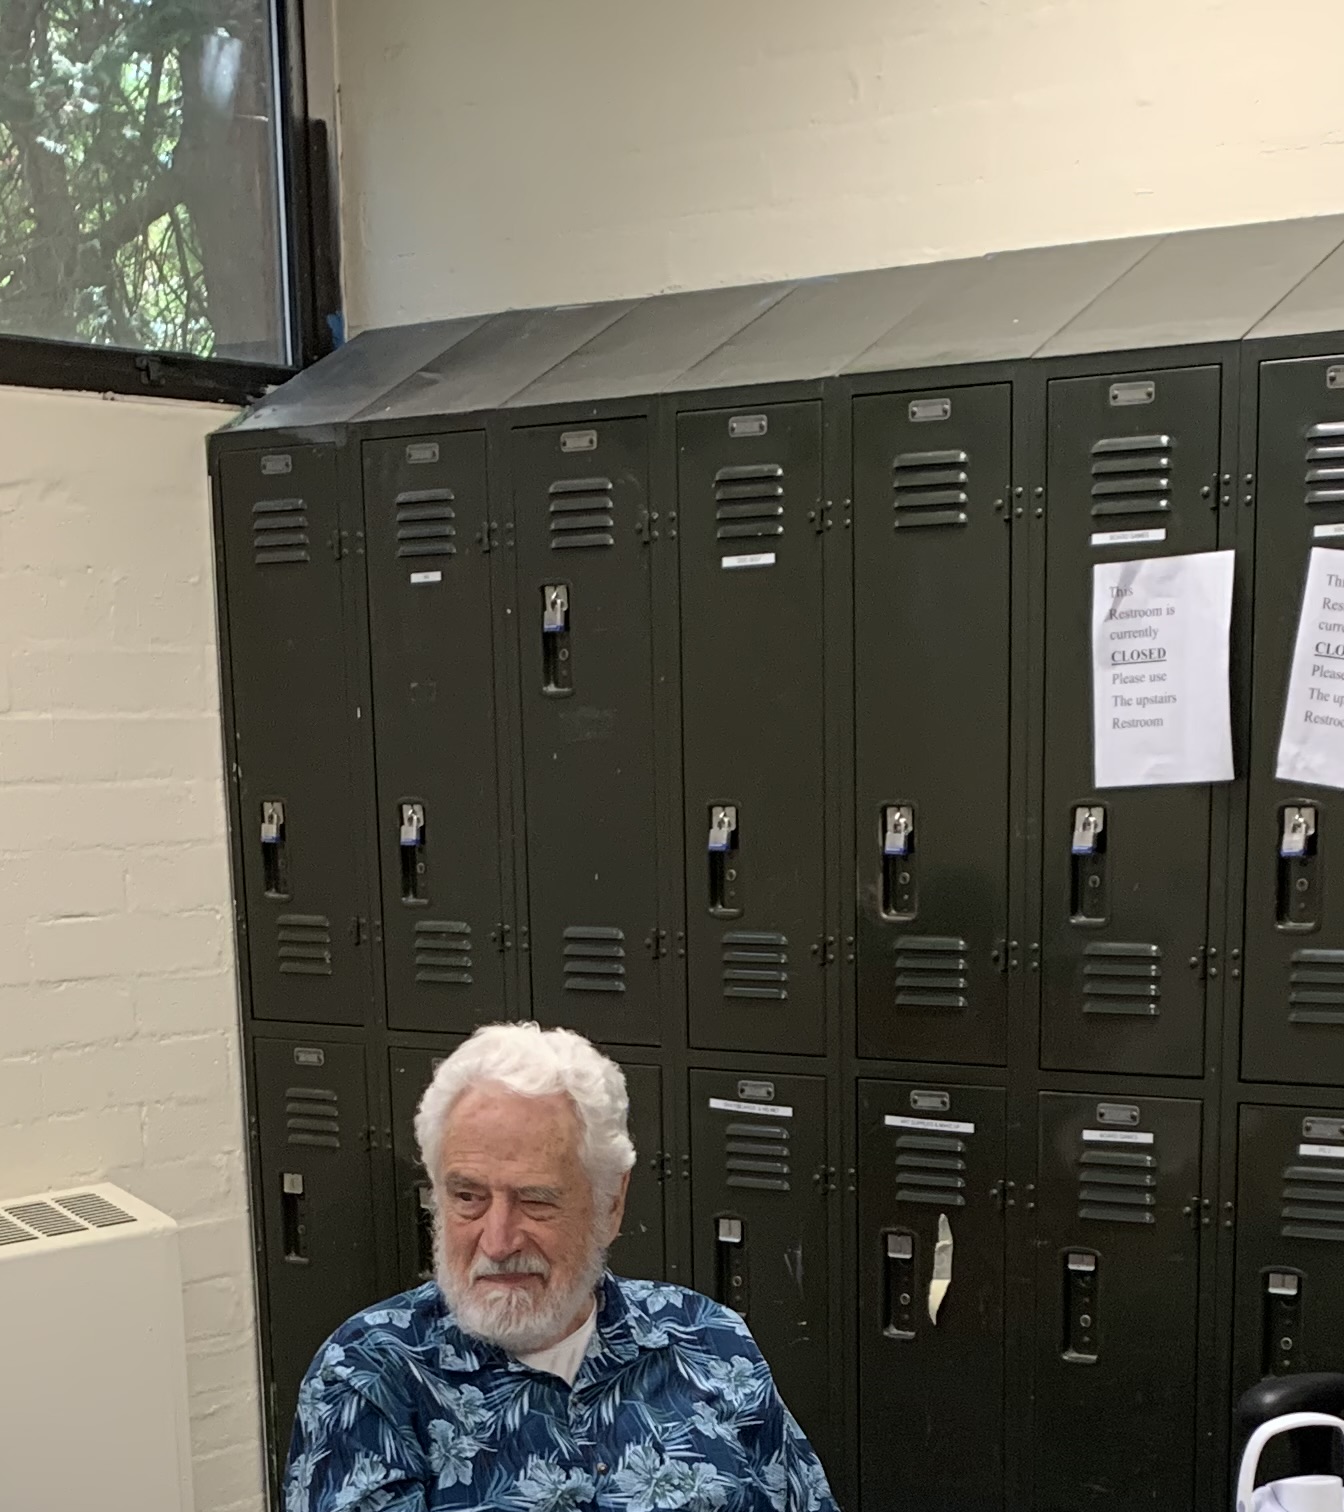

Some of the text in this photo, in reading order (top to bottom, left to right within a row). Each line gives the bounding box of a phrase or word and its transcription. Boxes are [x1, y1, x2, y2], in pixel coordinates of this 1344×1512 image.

[1109, 585, 1134, 599] This
[1109, 602, 1176, 620] Restroom is
[1109, 626, 1159, 641] currently
[1111, 647, 1167, 664] CLOSED
[1112, 672, 1168, 684] Please use
[1112, 691, 1178, 708] The upstairs
[1308, 687, 1331, 702] The
[1112, 717, 1164, 729] Restroom
